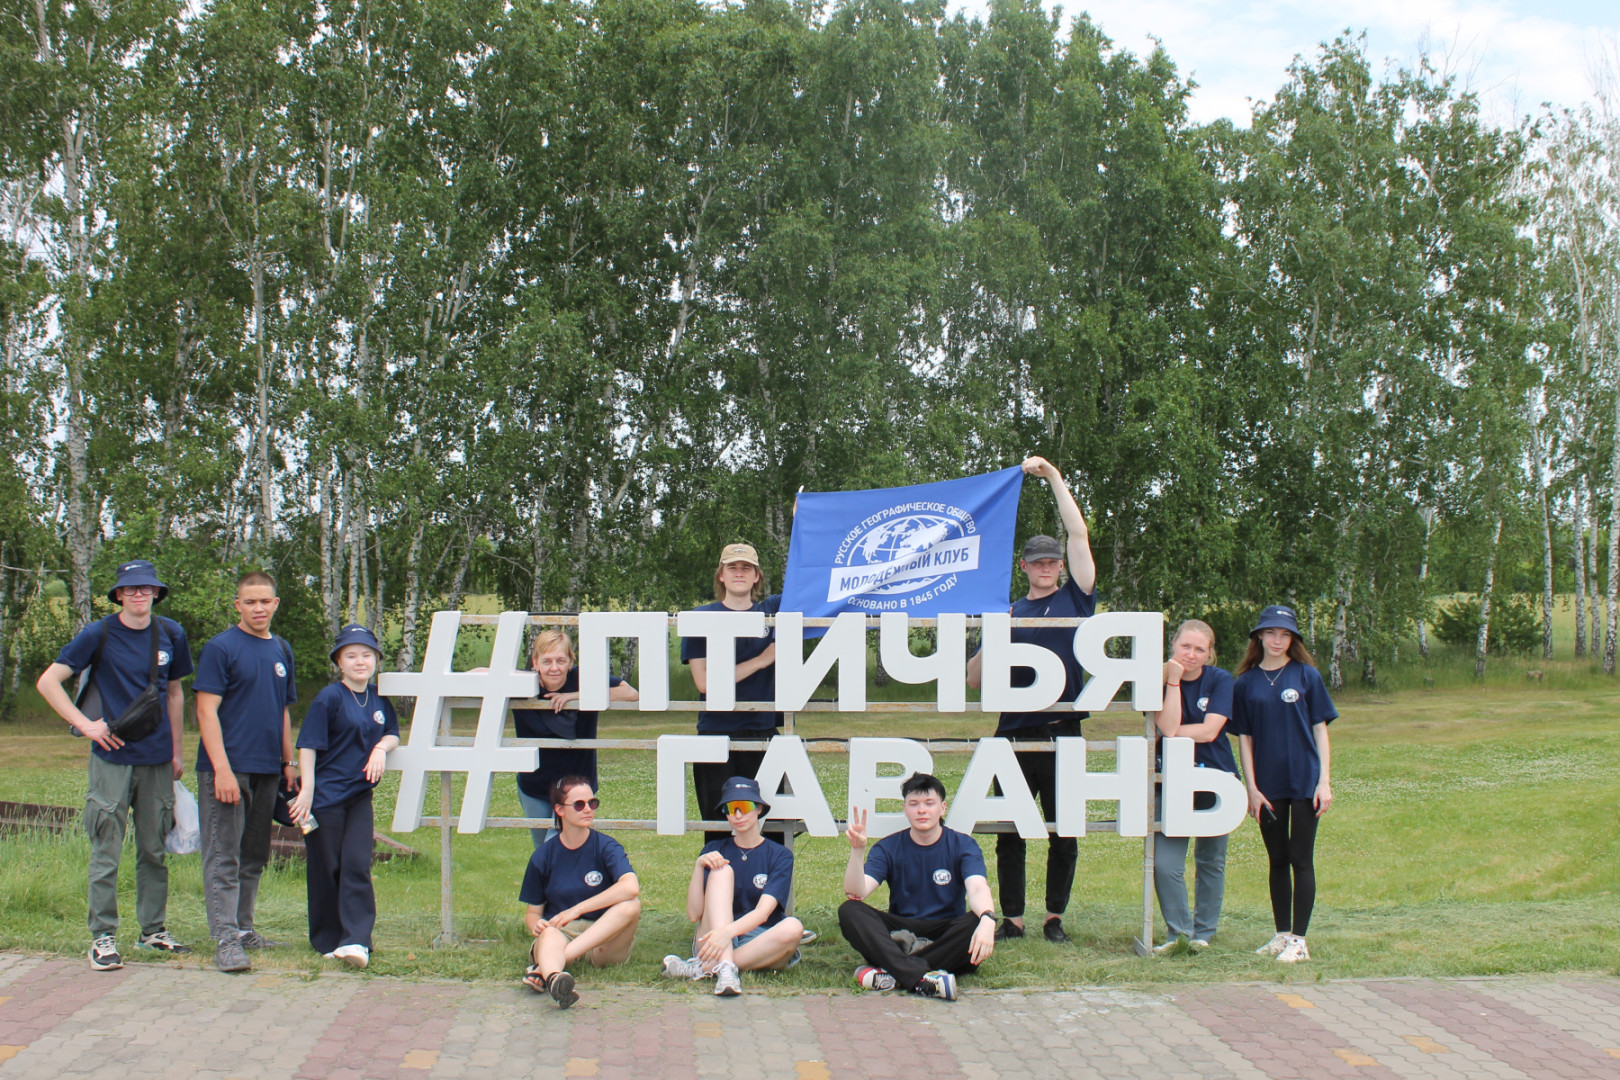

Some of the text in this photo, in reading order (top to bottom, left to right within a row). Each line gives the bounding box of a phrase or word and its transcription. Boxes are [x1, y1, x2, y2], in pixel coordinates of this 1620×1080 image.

[834, 501, 977, 565] РУССКОЕ ГЕОГРАФИЧЕСКОЕ ОБЩЕТВО
[933, 547, 969, 567] КЛУБ
[847, 573, 959, 610] ОСНОВАНО В 1845 ГОДУ
[656, 734, 1249, 840] ГАВАНЬ
